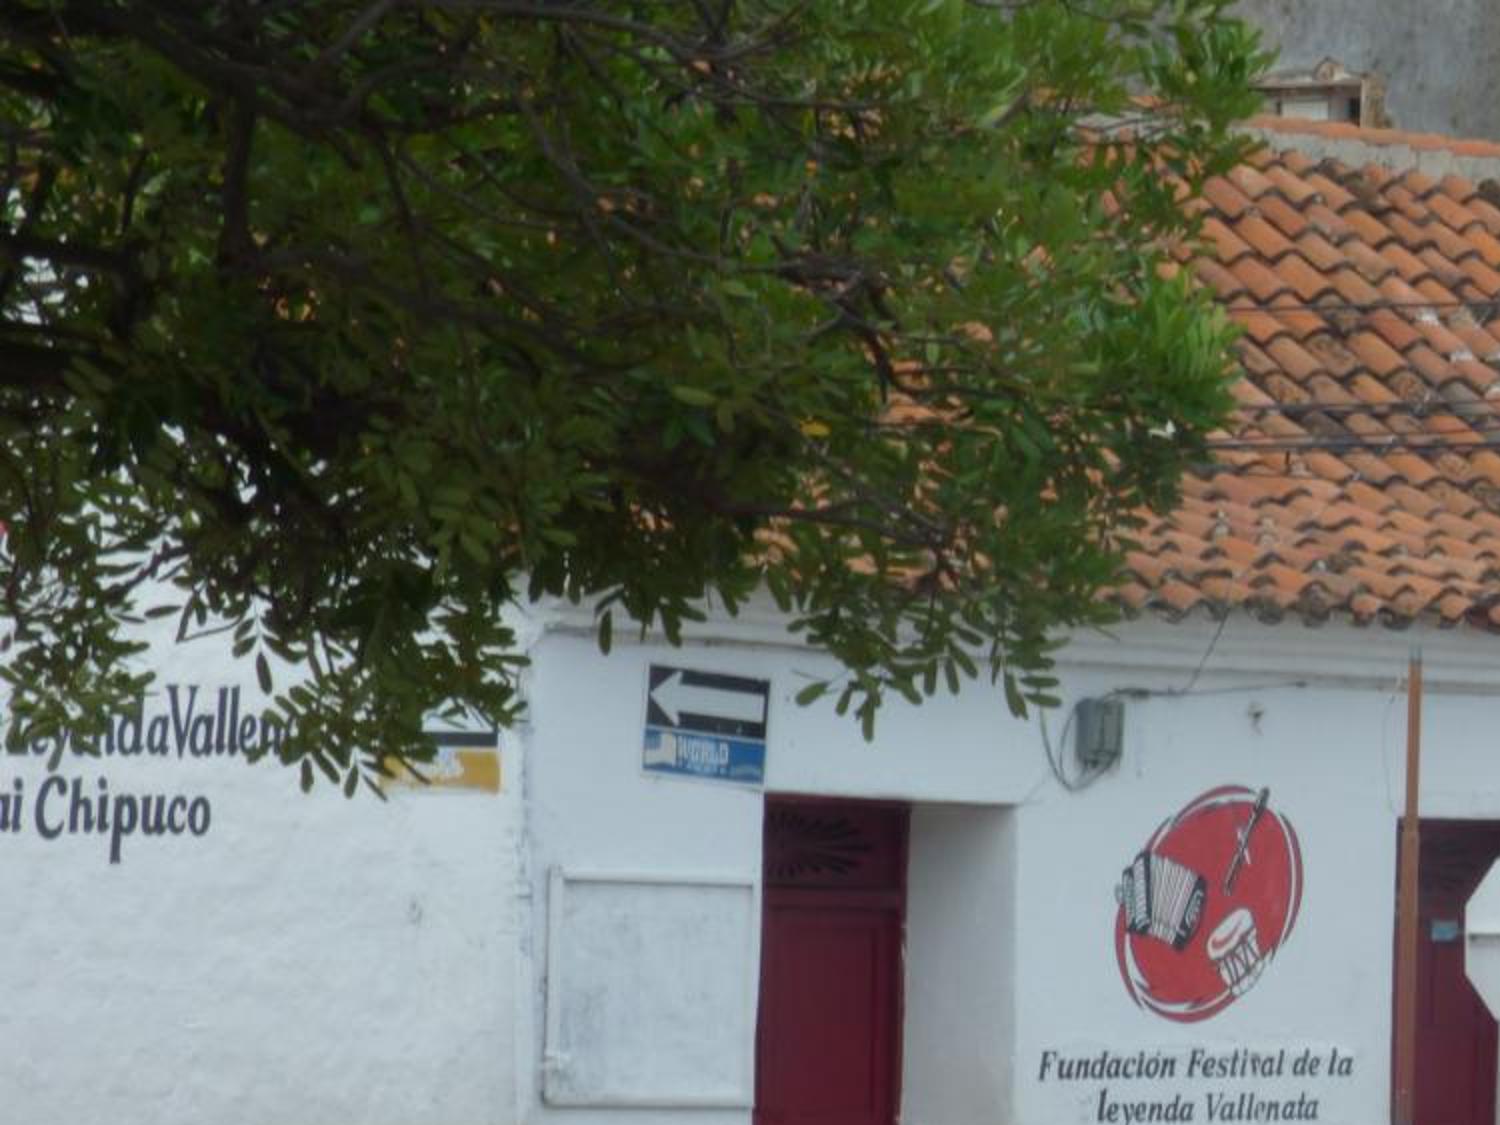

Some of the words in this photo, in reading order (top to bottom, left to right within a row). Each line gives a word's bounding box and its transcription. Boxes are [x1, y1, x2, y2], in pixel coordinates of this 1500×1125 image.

[34, 775, 212, 865] Chipuco
[1186, 1049, 1286, 1079] Festival
[1292, 1048, 1321, 1077] de
[1326, 1046, 1354, 1077] la
